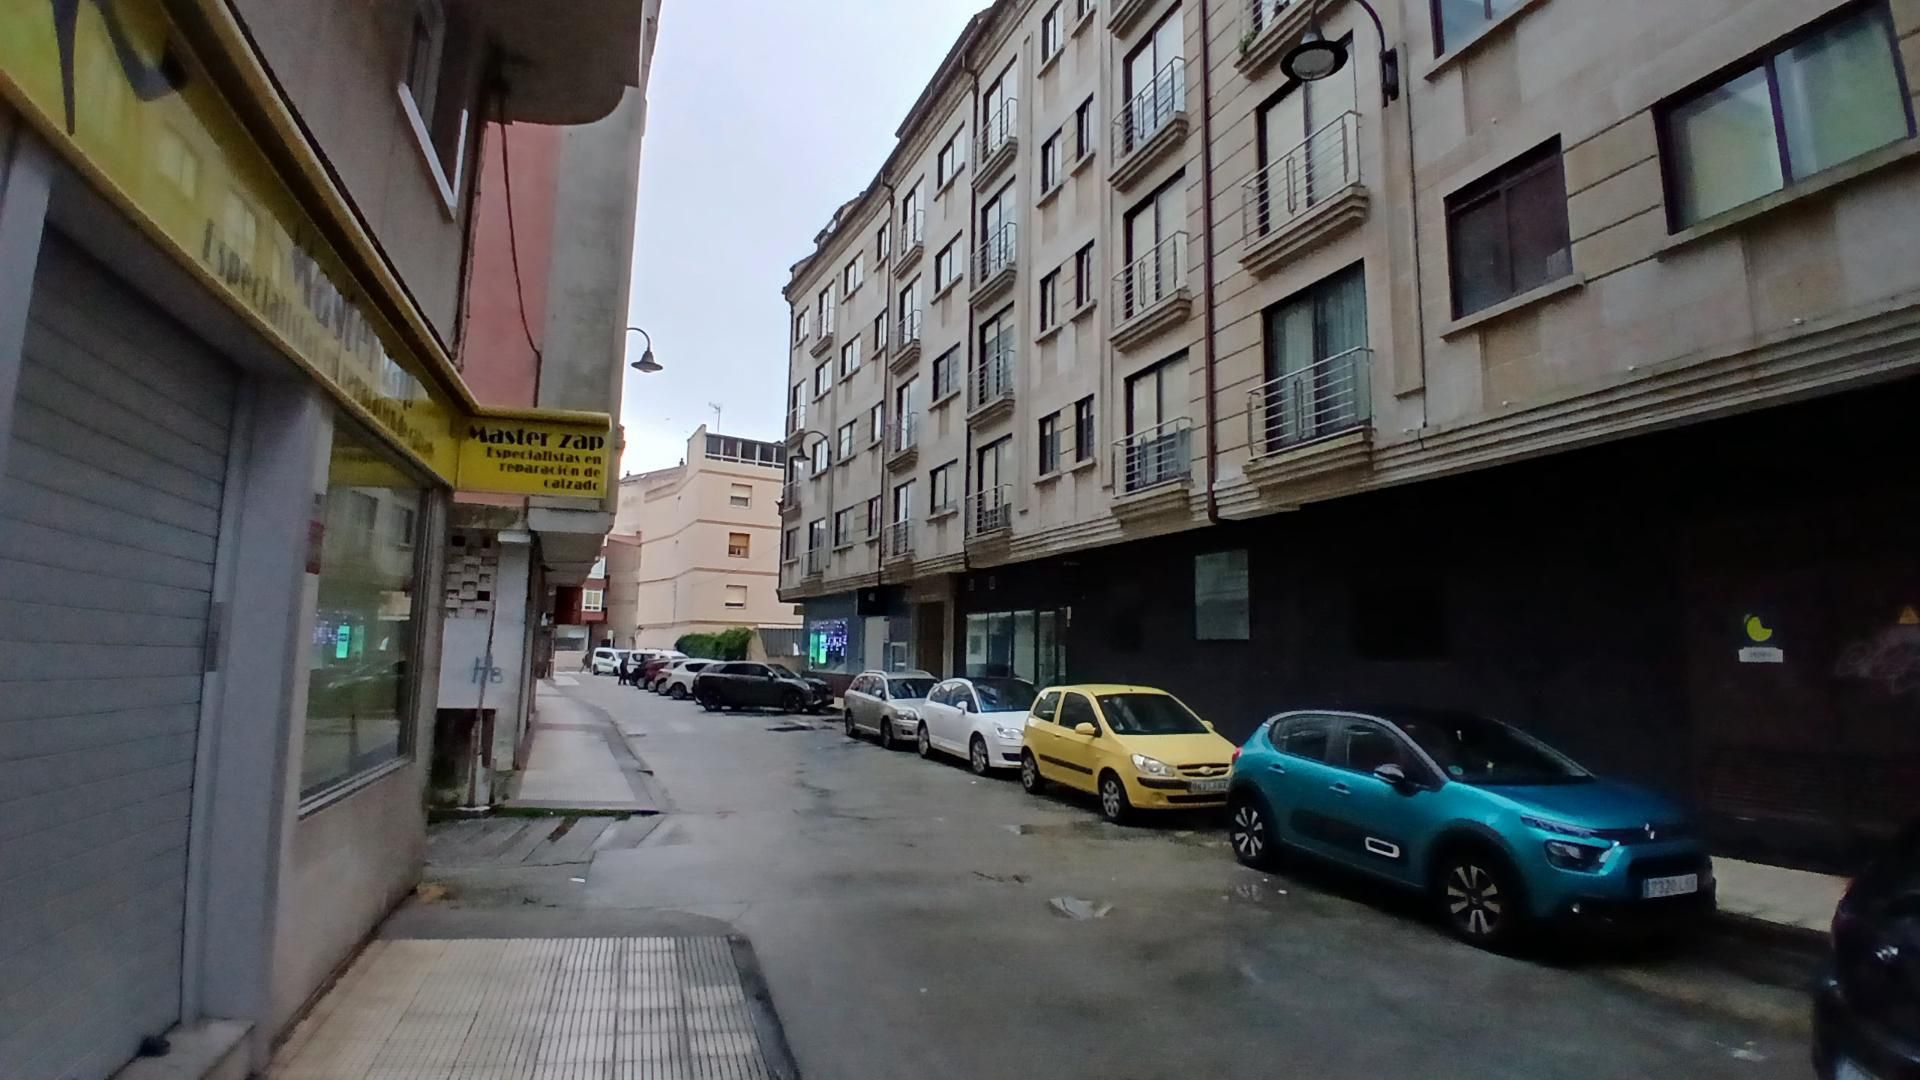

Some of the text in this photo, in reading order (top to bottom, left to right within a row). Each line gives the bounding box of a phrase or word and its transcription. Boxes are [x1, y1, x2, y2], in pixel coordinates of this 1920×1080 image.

[469, 425, 548, 447] Master
[486, 447, 601, 465] Especialistas en
[584, 467, 600, 477] de
[544, 478, 599, 491] calzado
